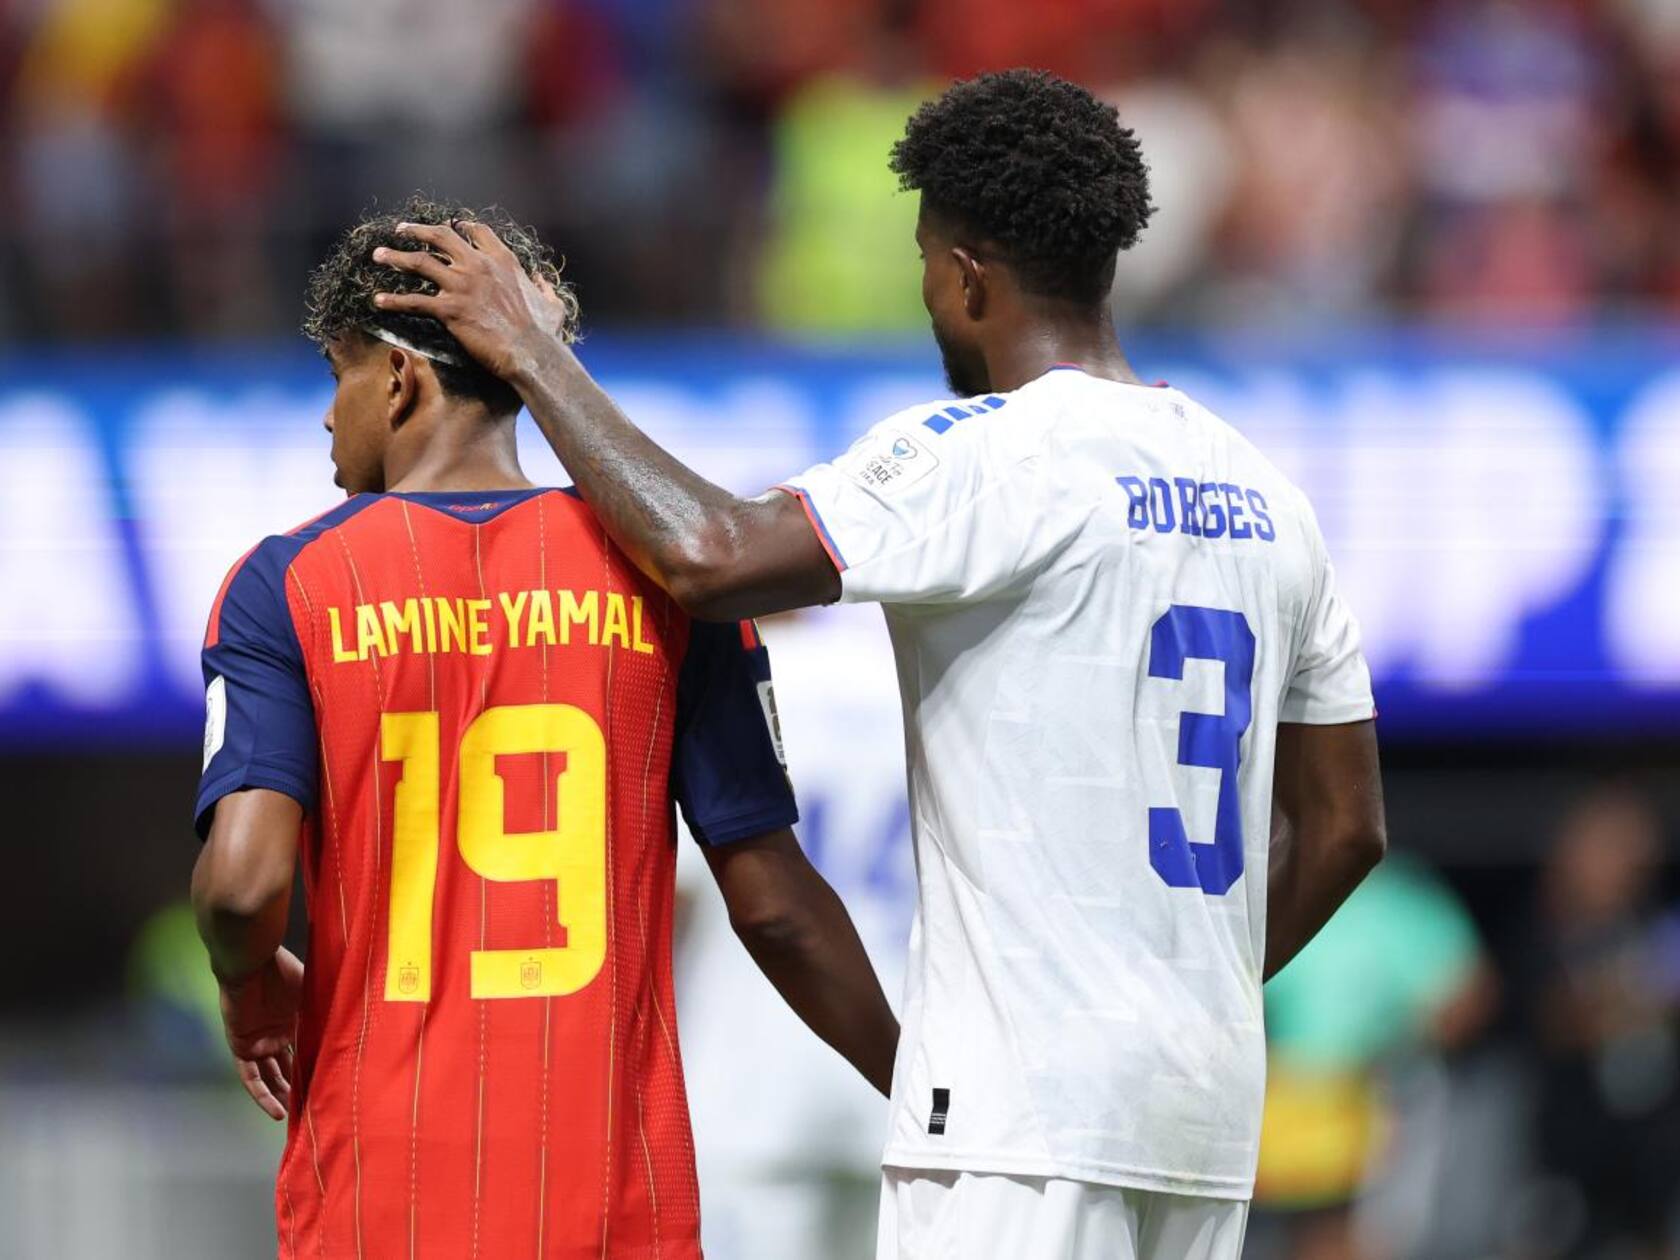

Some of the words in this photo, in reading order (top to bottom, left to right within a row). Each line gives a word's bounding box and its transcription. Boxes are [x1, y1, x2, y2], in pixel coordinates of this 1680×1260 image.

[1115, 476, 1276, 542] BORGES
[327, 597, 493, 663] LAMINE
[498, 590, 654, 655] YAMAL
[1148, 604, 1256, 896] 3
[380, 703, 608, 1003] 19
